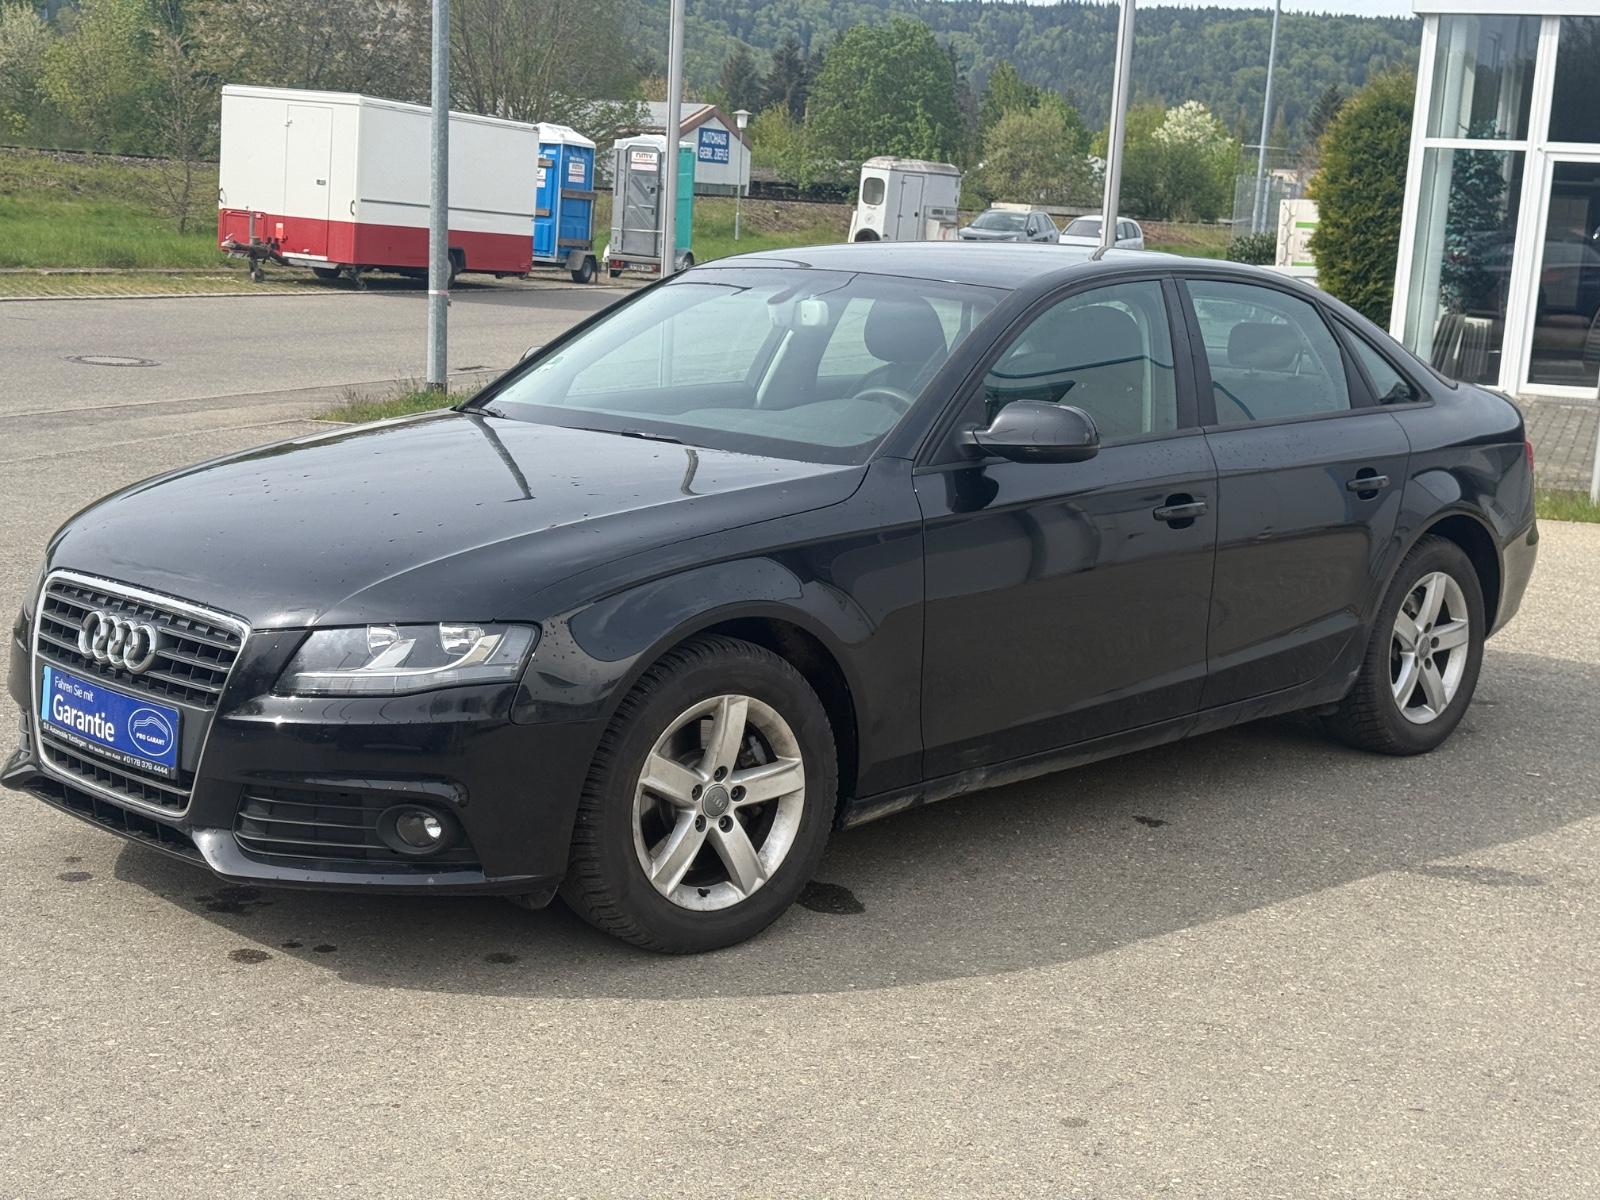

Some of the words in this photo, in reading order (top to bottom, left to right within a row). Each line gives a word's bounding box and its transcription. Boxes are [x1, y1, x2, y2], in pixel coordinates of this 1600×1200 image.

[702, 131, 727, 146] AUTOHAUS
[54, 676, 73, 694] Fahren
[73, 684, 83, 698] Sie
[83, 689, 94, 703] mit
[53, 693, 115, 742] Garantie
[136, 732, 146, 741] PRO
[146, 735, 165, 746] GARANT
